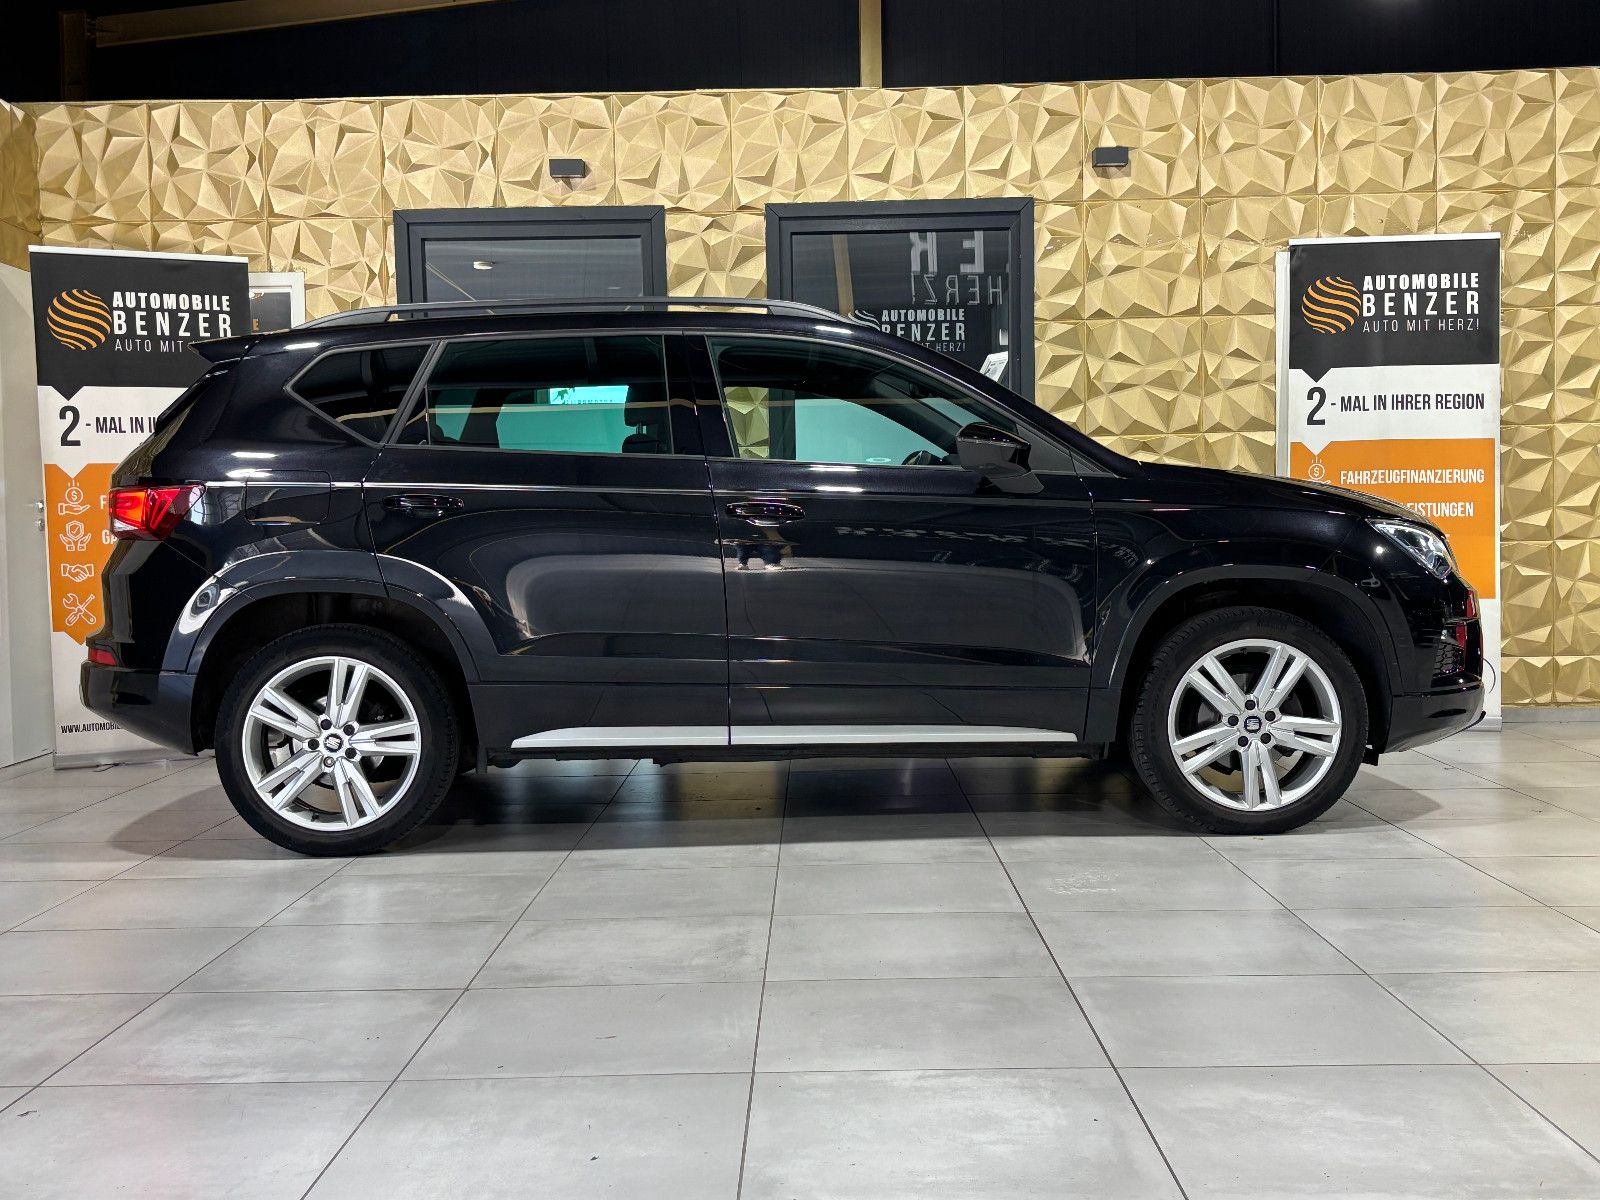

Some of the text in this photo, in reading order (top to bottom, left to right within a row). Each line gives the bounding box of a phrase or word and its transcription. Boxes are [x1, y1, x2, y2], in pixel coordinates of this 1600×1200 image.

[1362, 272, 1479, 291] AUTOMOBILE
[112, 291, 231, 311] AUTOMOBILE
[1362, 290, 1479, 317] BENZER
[112, 310, 232, 338] BENZER
[881, 308, 965, 322] AUTOMOBILE
[1362, 318, 1479, 333] AUTO MIT HERZ!
[114, 338, 184, 353] AUTO MIT
[1306, 386, 1327, 426] 2
[1340, 395, 1370, 412] MAL
[1373, 394, 1387, 411] IN
[1391, 393, 1431, 411] IHRER
[1435, 392, 1485, 410] REGION
[59, 405, 81, 446] 2
[95, 416, 126, 434] MAL
[130, 416, 145, 434] IN
[1340, 468, 1485, 485] FAHRZEUGFINANZIERUNG
